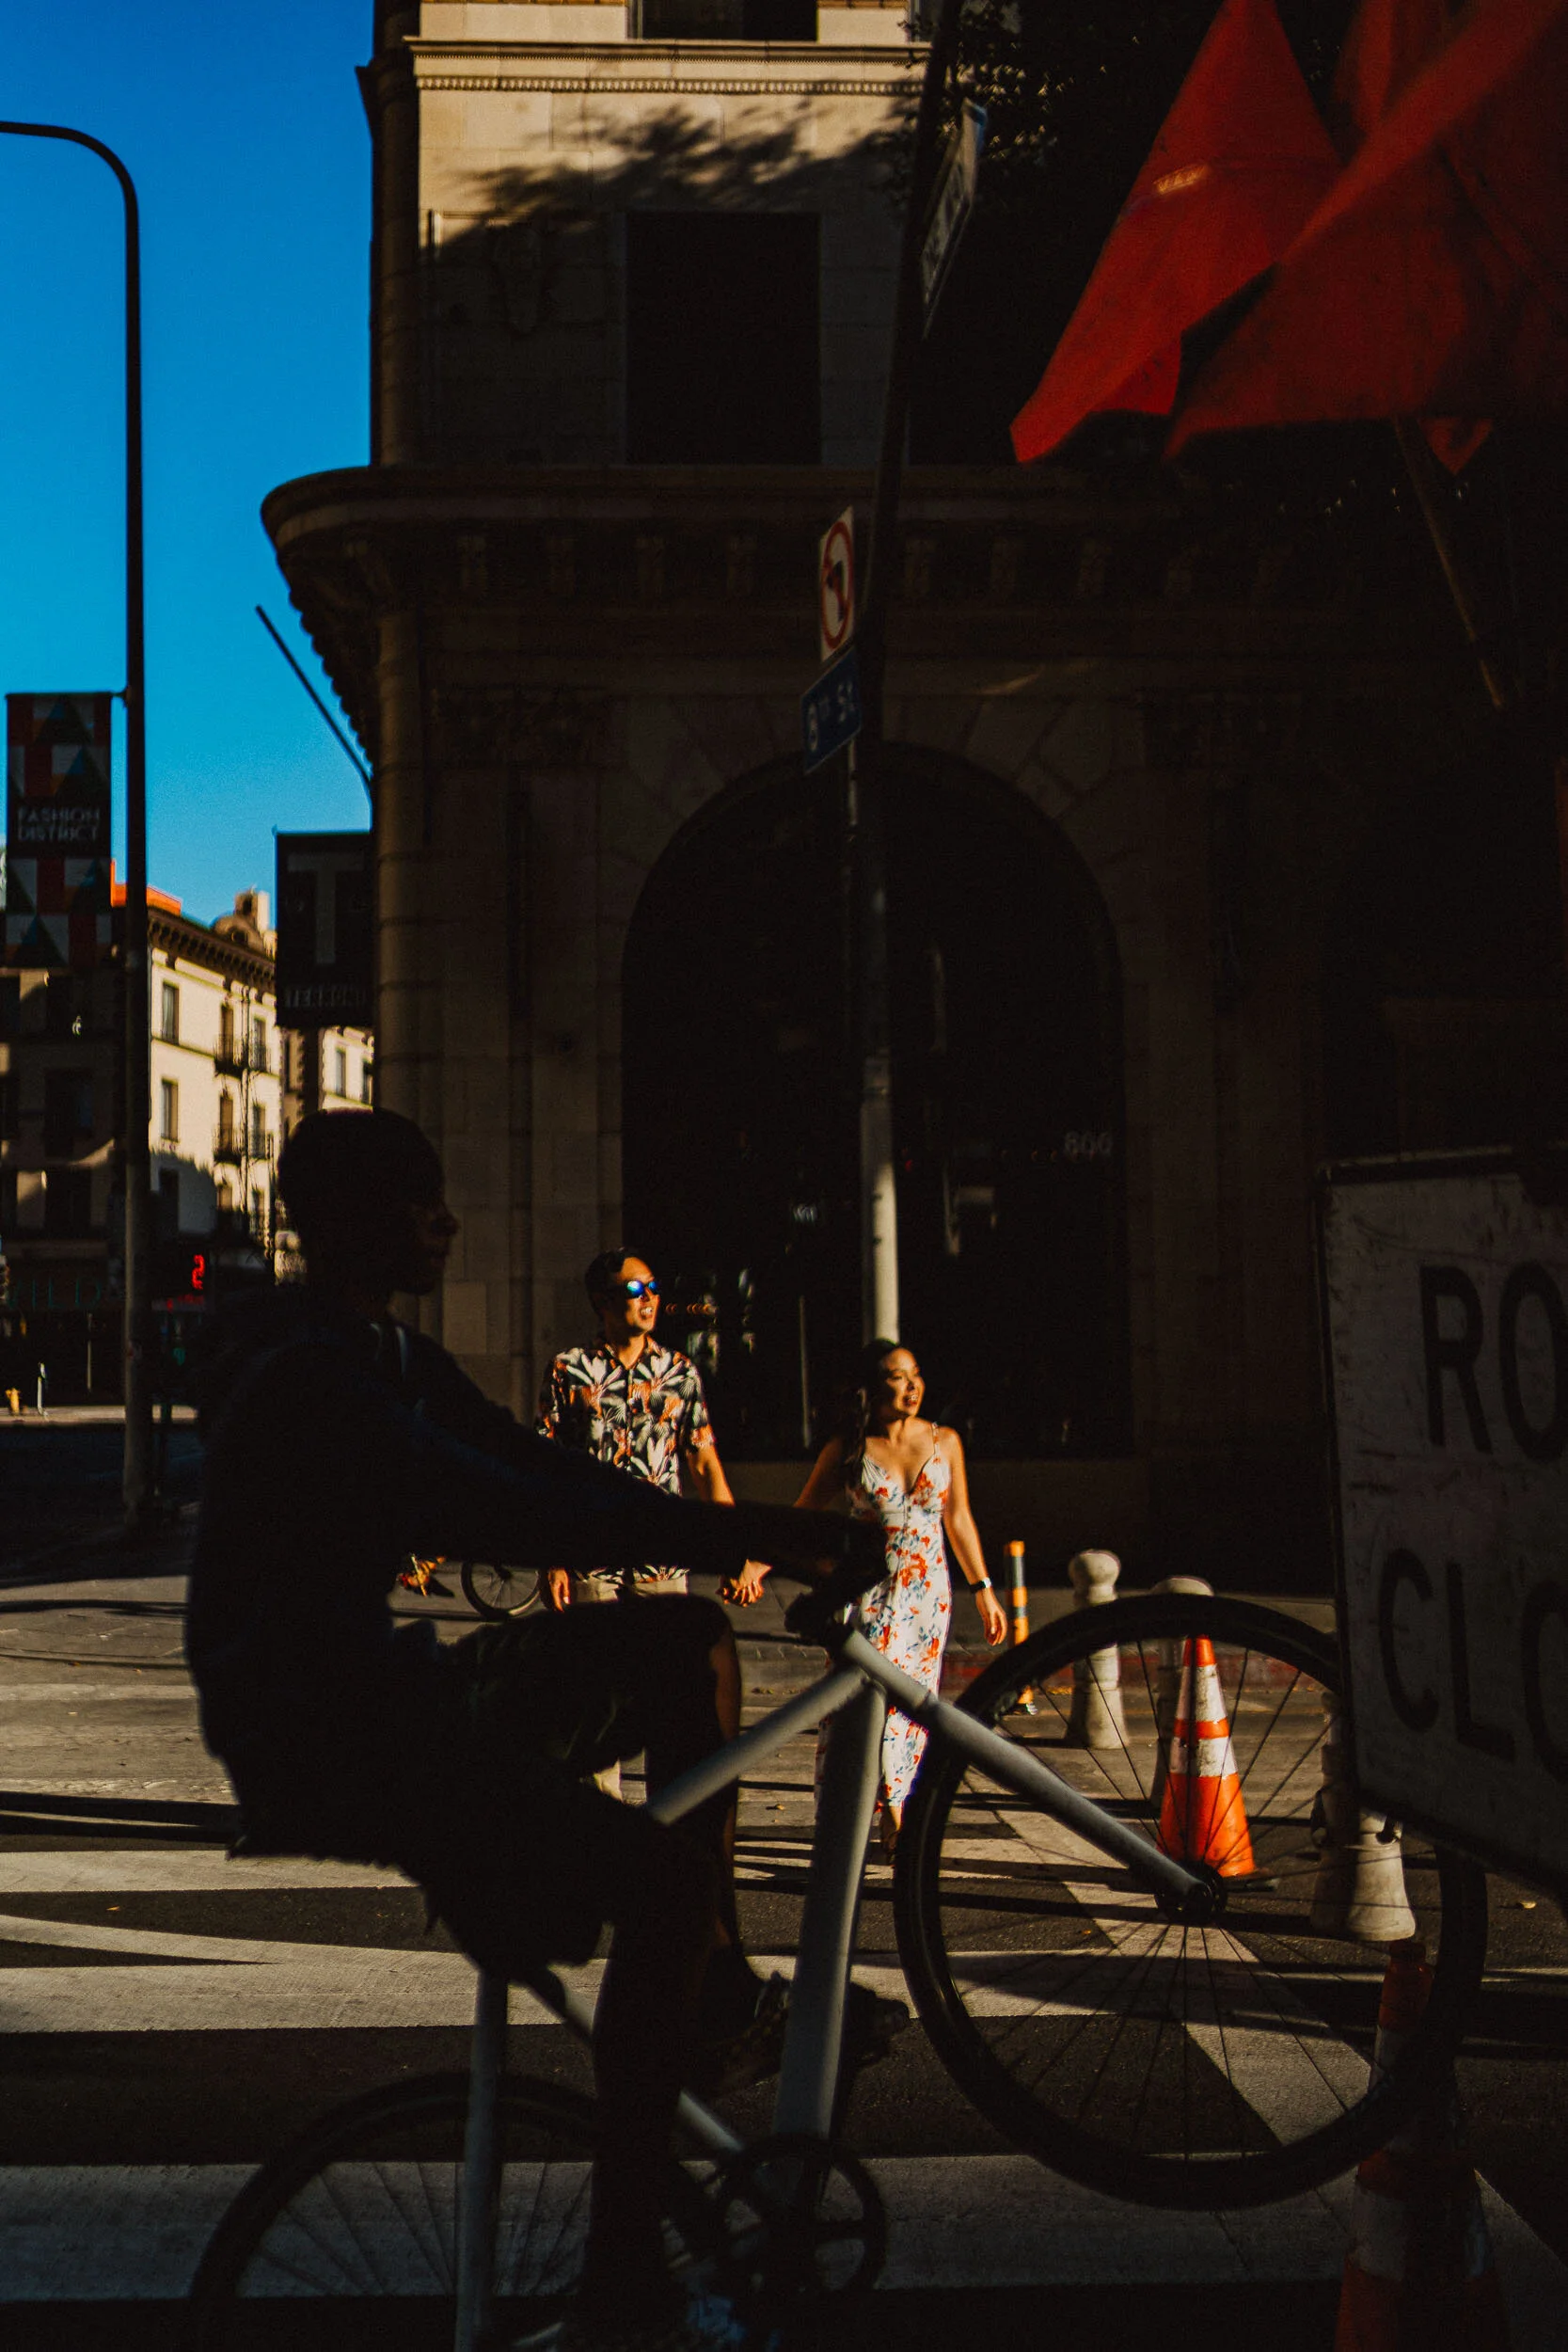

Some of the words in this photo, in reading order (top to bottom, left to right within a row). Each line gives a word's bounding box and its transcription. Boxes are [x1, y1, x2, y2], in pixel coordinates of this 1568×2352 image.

[16, 806, 101, 824] FASHION
[17, 826, 98, 842] DISTRICT
[286, 852, 366, 965] T
[191, 1253, 206, 1291] 2
